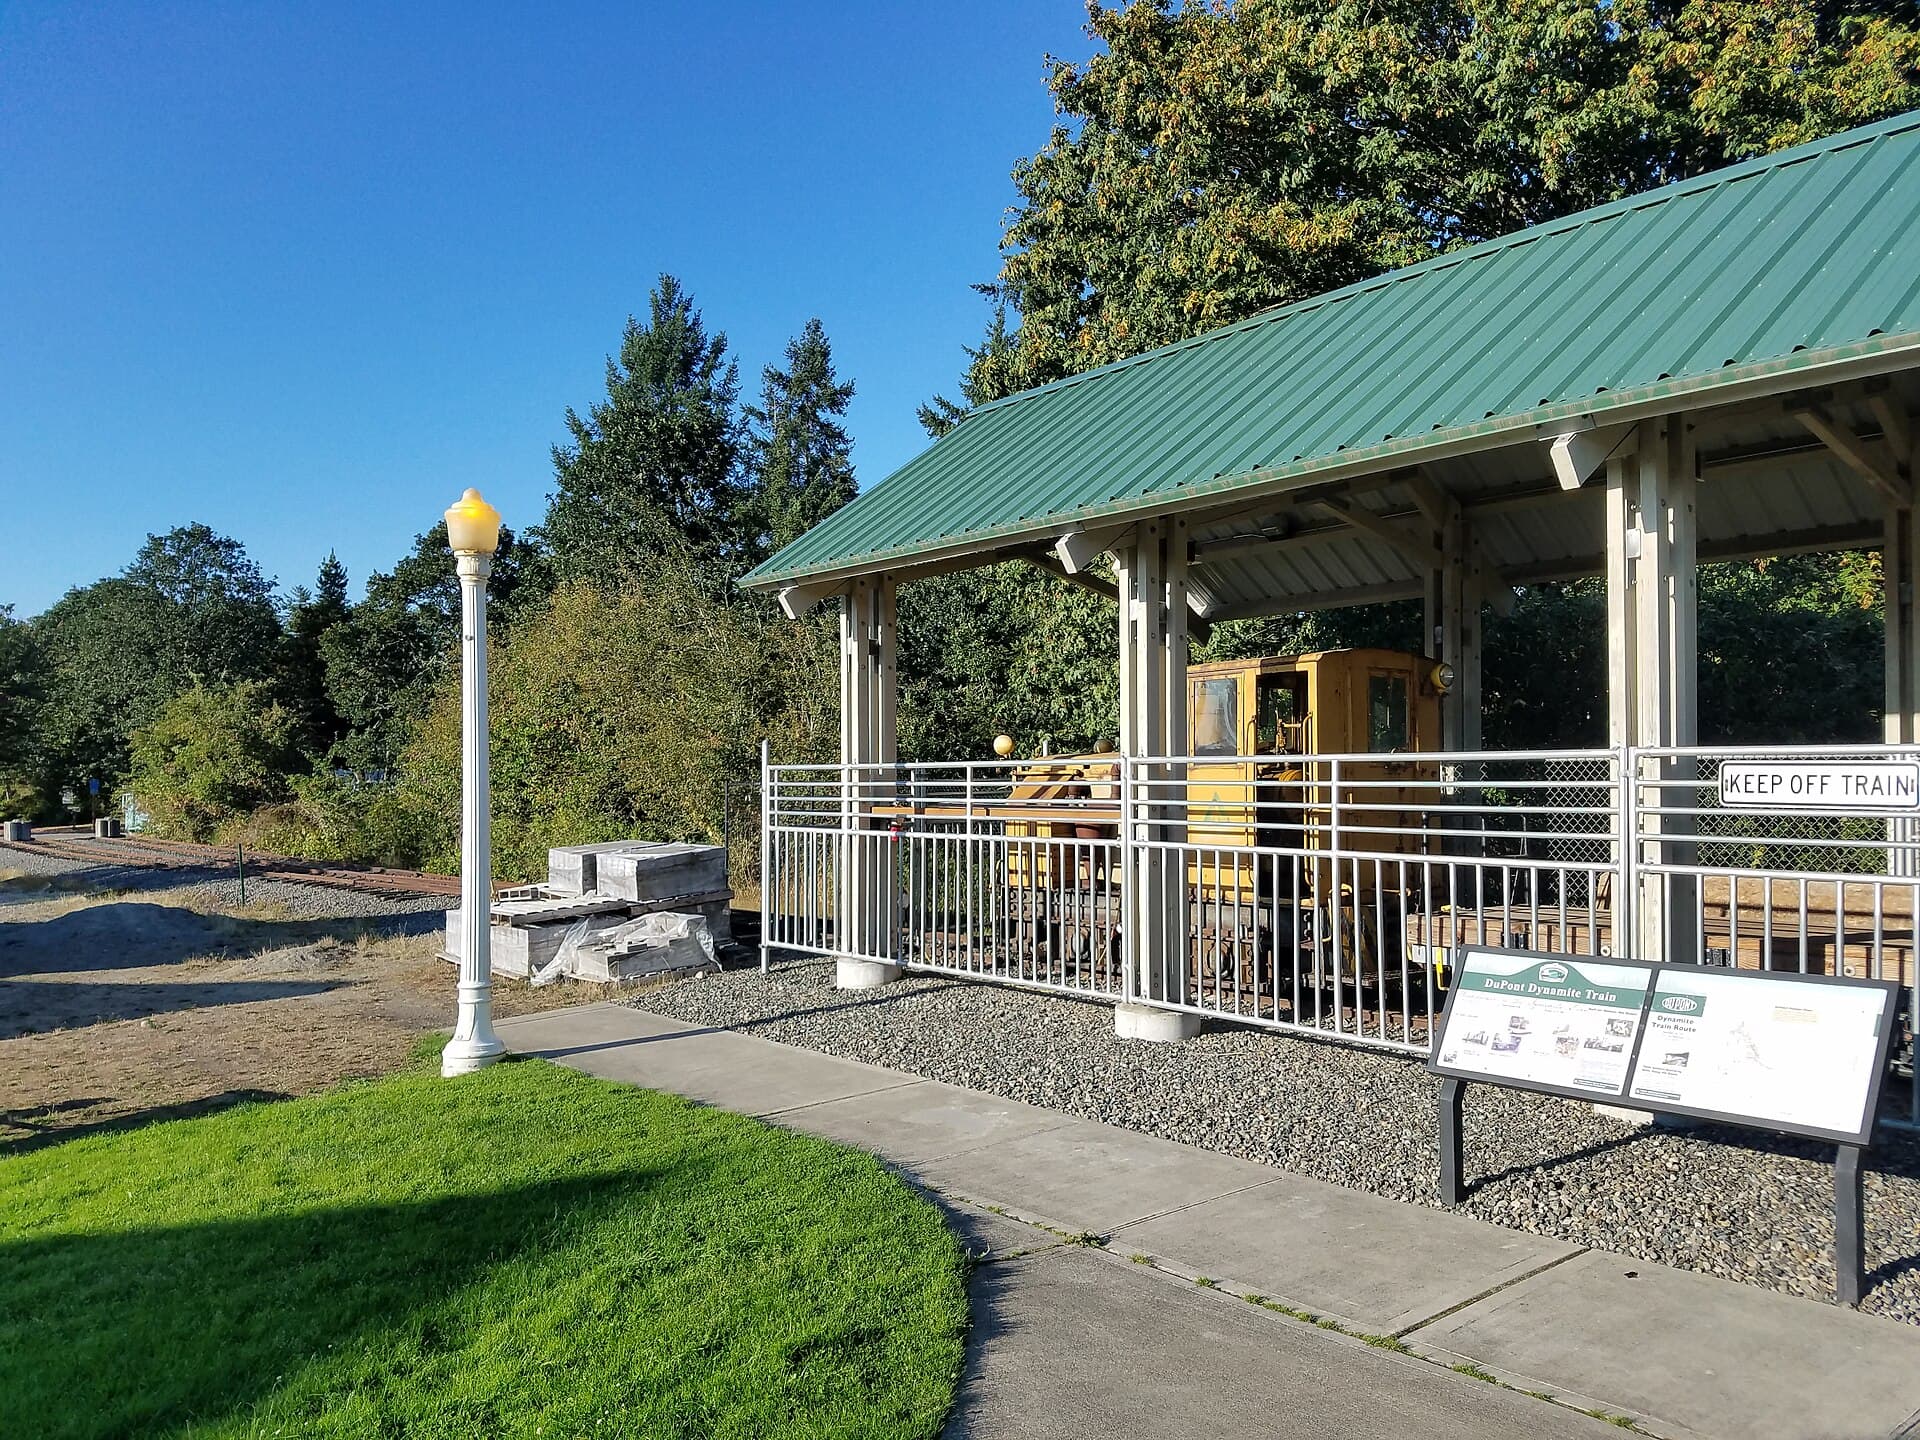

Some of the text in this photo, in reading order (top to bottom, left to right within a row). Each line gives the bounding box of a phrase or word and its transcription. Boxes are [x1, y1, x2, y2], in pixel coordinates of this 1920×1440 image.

[1729, 774, 1910, 796] KEEP OFF TRAIN
[1484, 978, 1617, 1002] DuPont Dynamite Train
[1652, 1022, 1697, 1033] Train Route
[1657, 1015, 1695, 1025] Dynamite
